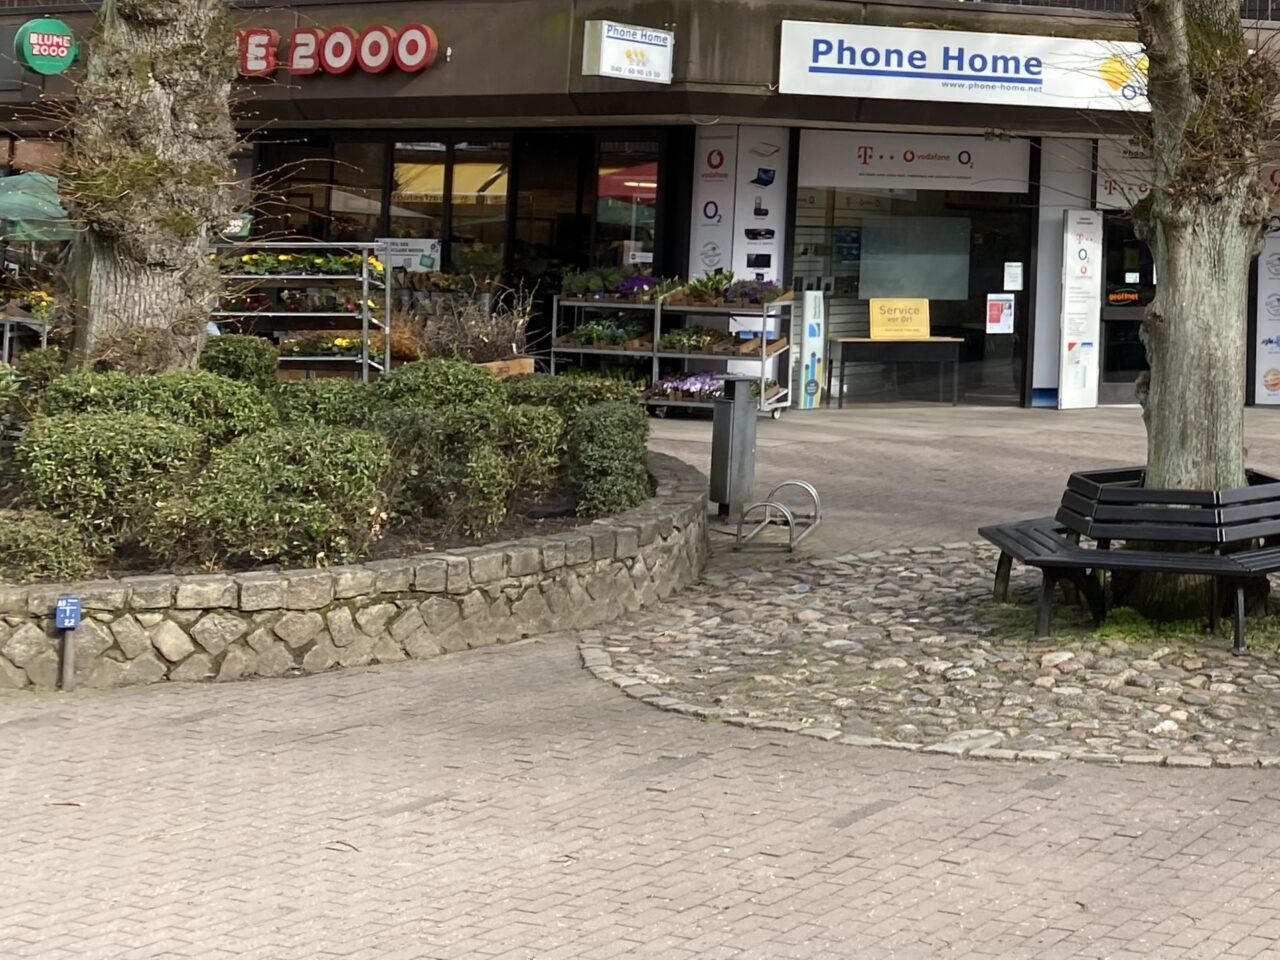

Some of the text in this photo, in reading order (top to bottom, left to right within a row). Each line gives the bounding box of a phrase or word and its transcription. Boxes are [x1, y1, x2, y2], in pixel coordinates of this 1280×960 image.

[29, 32, 71, 47] BLUME
[606, 24, 669, 44] Phone Home
[32, 44, 68, 57] 2000
[291, 27, 430, 73] 2000
[811, 38, 1043, 76] Phone Home
[941, 80, 1043, 94] www.phone-home.net
[916, 152, 951, 162] vodafone
[879, 304, 920, 316] Service
